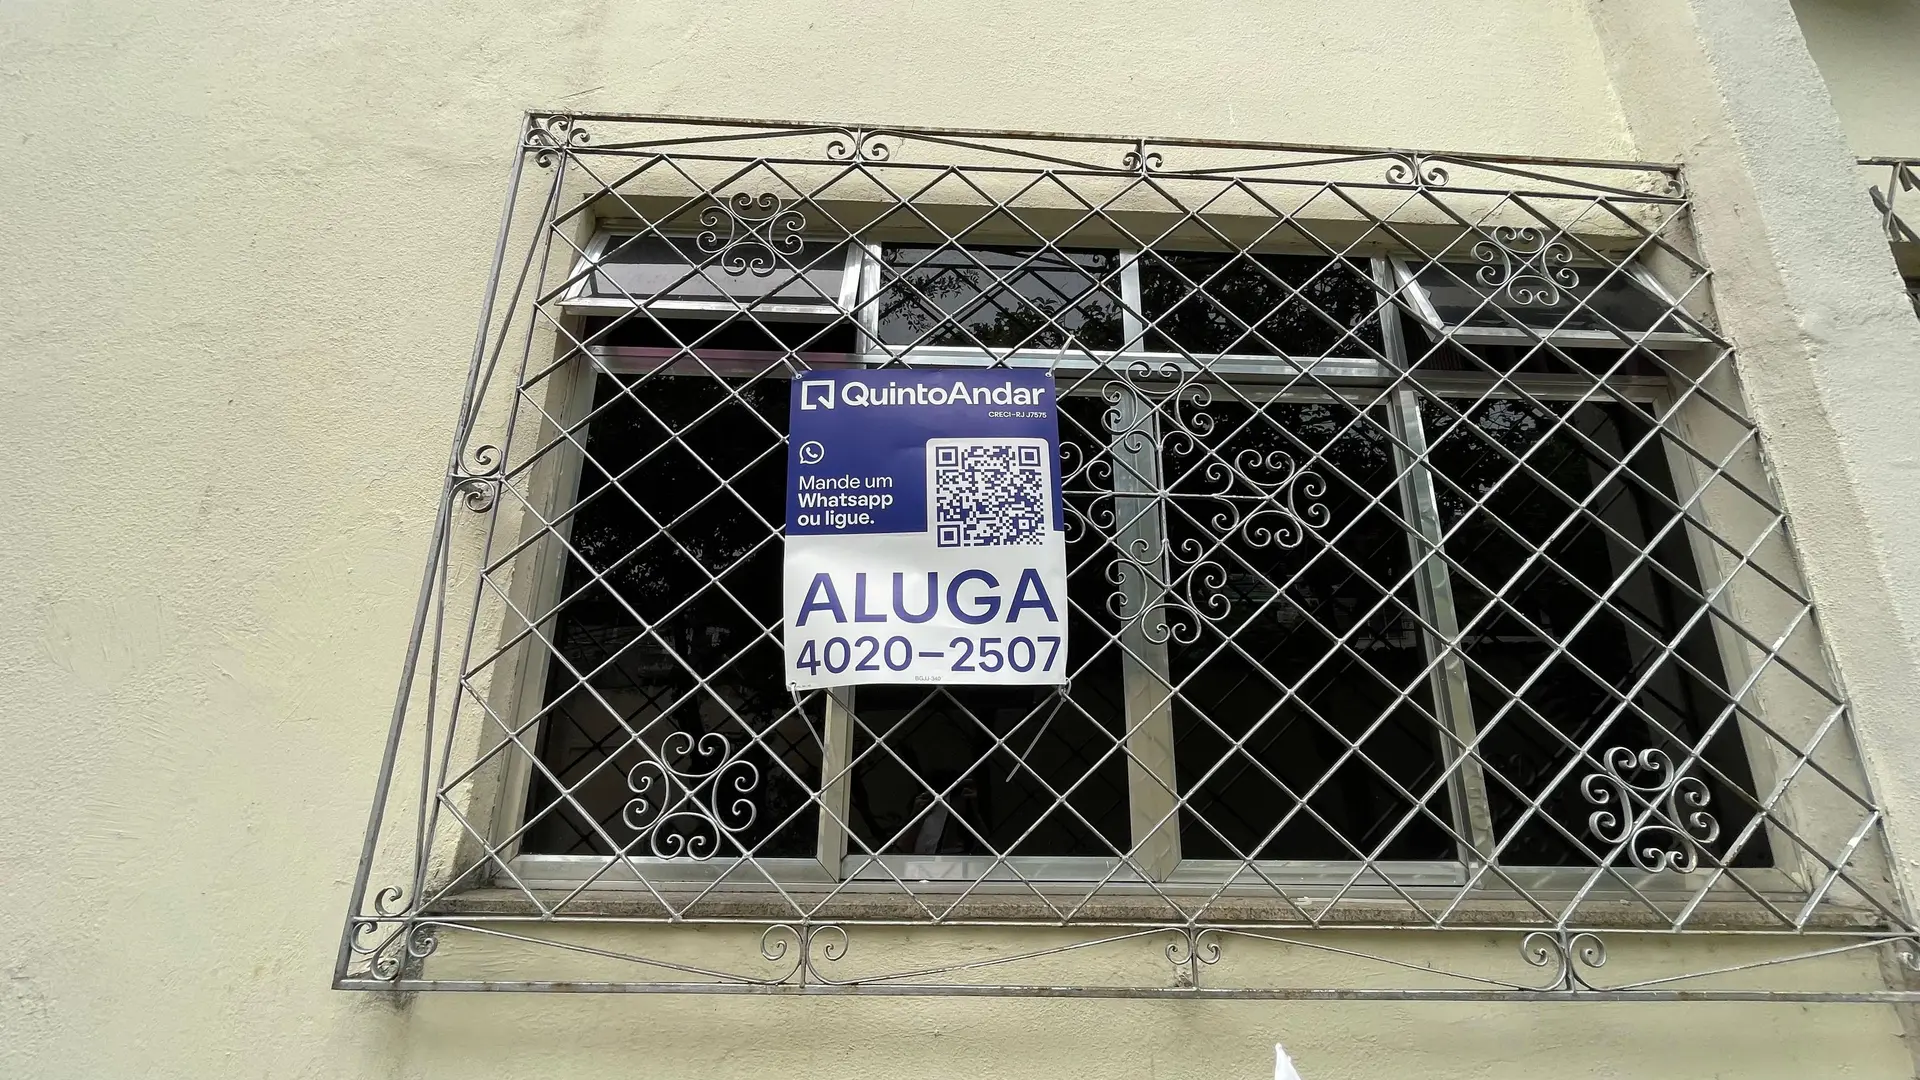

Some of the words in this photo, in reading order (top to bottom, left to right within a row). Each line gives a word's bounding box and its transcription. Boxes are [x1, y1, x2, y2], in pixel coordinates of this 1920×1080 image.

[841, 381, 1046, 408] QuintoAndar
[1026, 411, 1047, 419] J7575
[798, 474, 860, 490] Mande
[864, 475, 893, 488] um
[798, 492, 894, 509] Whatsapp
[797, 513, 823, 527] ou
[825, 510, 875, 530] ligue.
[795, 568, 1060, 628] ALUGA
[796, 635, 1062, 677] 4020-2507
